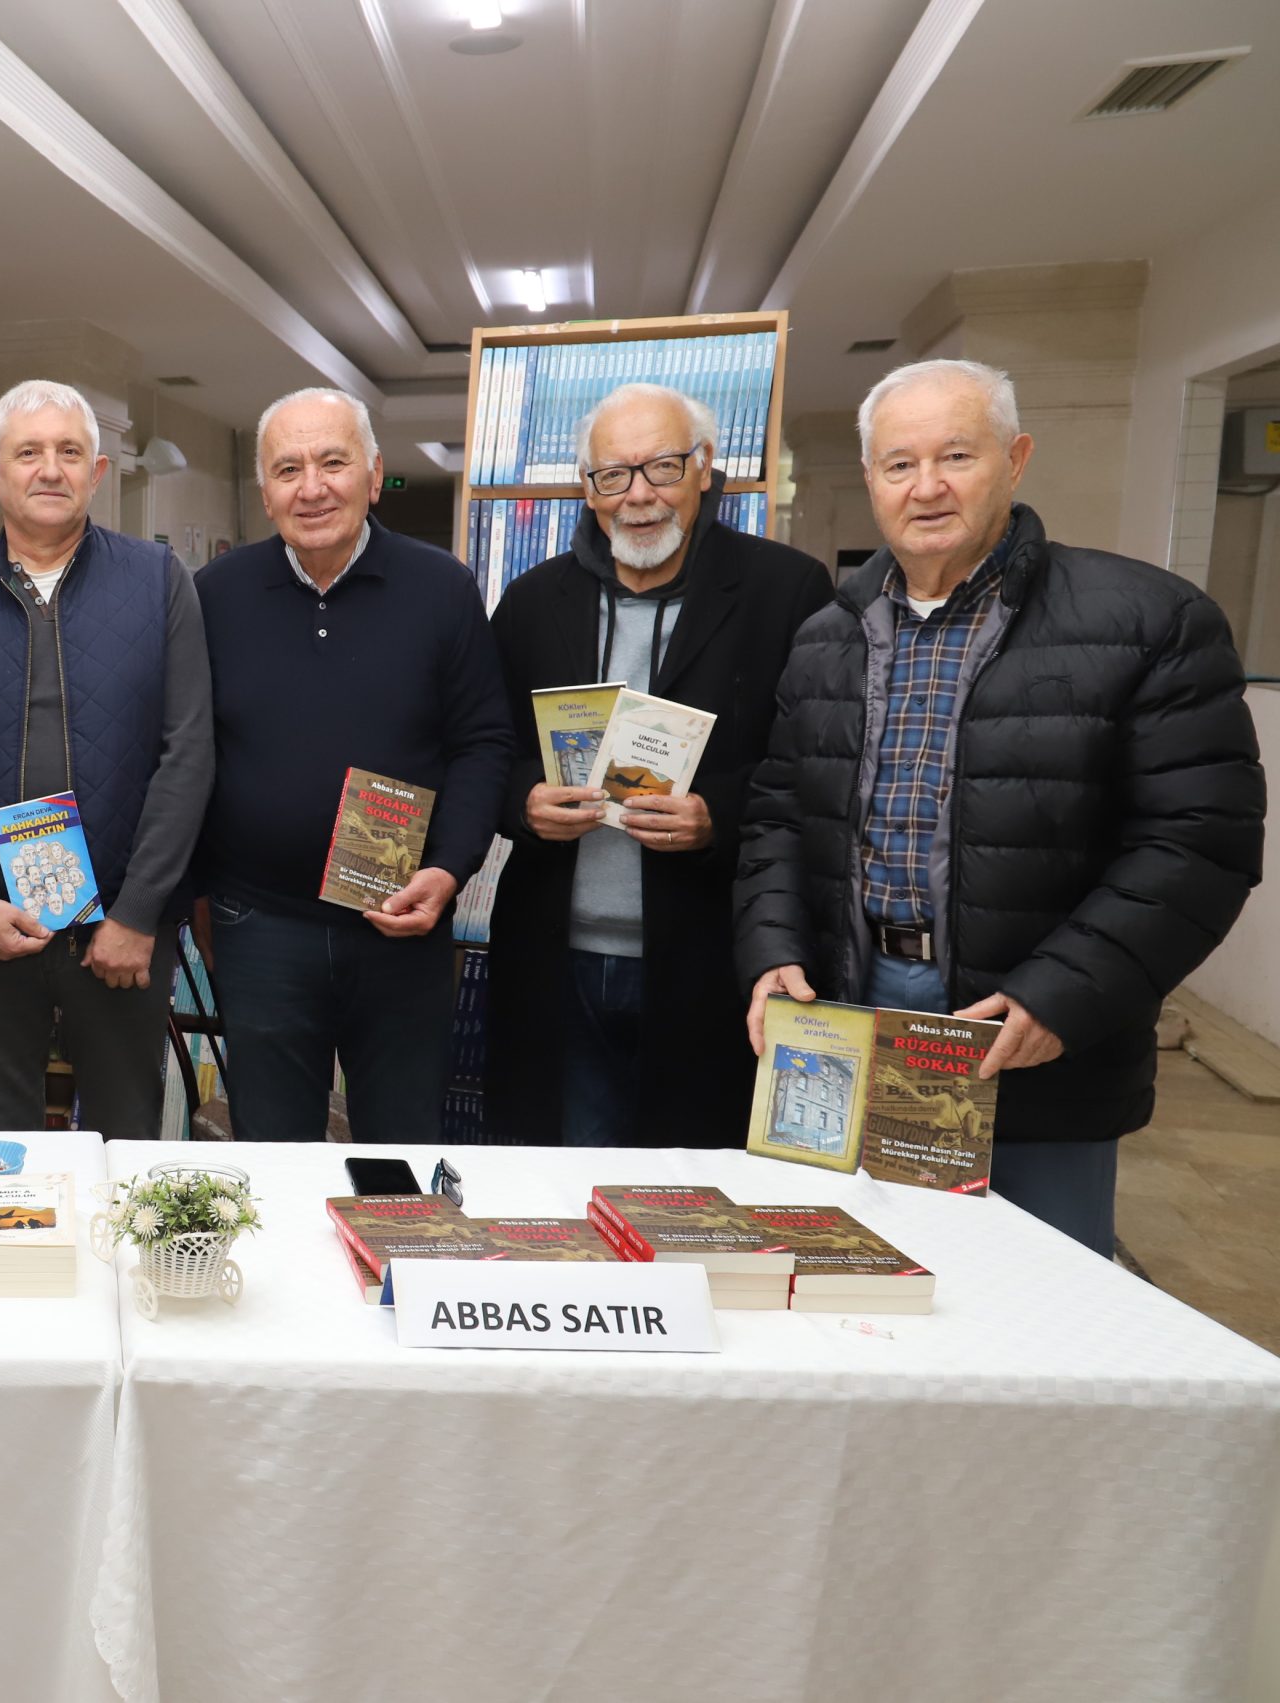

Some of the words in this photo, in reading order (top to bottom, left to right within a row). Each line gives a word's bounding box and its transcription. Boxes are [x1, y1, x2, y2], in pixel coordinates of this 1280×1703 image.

[558, 703, 587, 712] KÖKleri
[632, 741, 670, 757] YOLCULUK
[638, 734, 661, 746] UMUT'
[372, 782, 393, 793] Abbas
[395, 788, 415, 800] SATIR
[1, 811, 69, 834] KAHKAHAYI
[13, 811, 34, 820] ERCAN
[36, 807, 52, 815] DEVA
[365, 806, 409, 826] SOKAK
[10, 823, 65, 842] PATLATIN
[339, 874, 366, 887] Mürekkep
[367, 882, 385, 892] Kokulu
[349, 869, 373, 881] Dönemin
[374, 876, 388, 885] Basın
[794, 1015, 830, 1029] KÖKleri
[910, 1023, 940, 1035] Abbas
[944, 1028, 972, 1039] SATIR
[905, 1056, 970, 1074] SOKAK
[881, 1138, 893, 1146] Bir
[894, 1140, 929, 1152] Dönemin
[931, 1146, 952, 1155] Basın
[953, 1149, 976, 1159] Tarihi
[881, 1147, 920, 1161] Mürekkep
[921, 1154, 948, 1164] Kokulu
[950, 1158, 974, 1168] Anılar
[431, 1301, 552, 1332] ABBAS
[562, 1304, 667, 1335] SATIR
